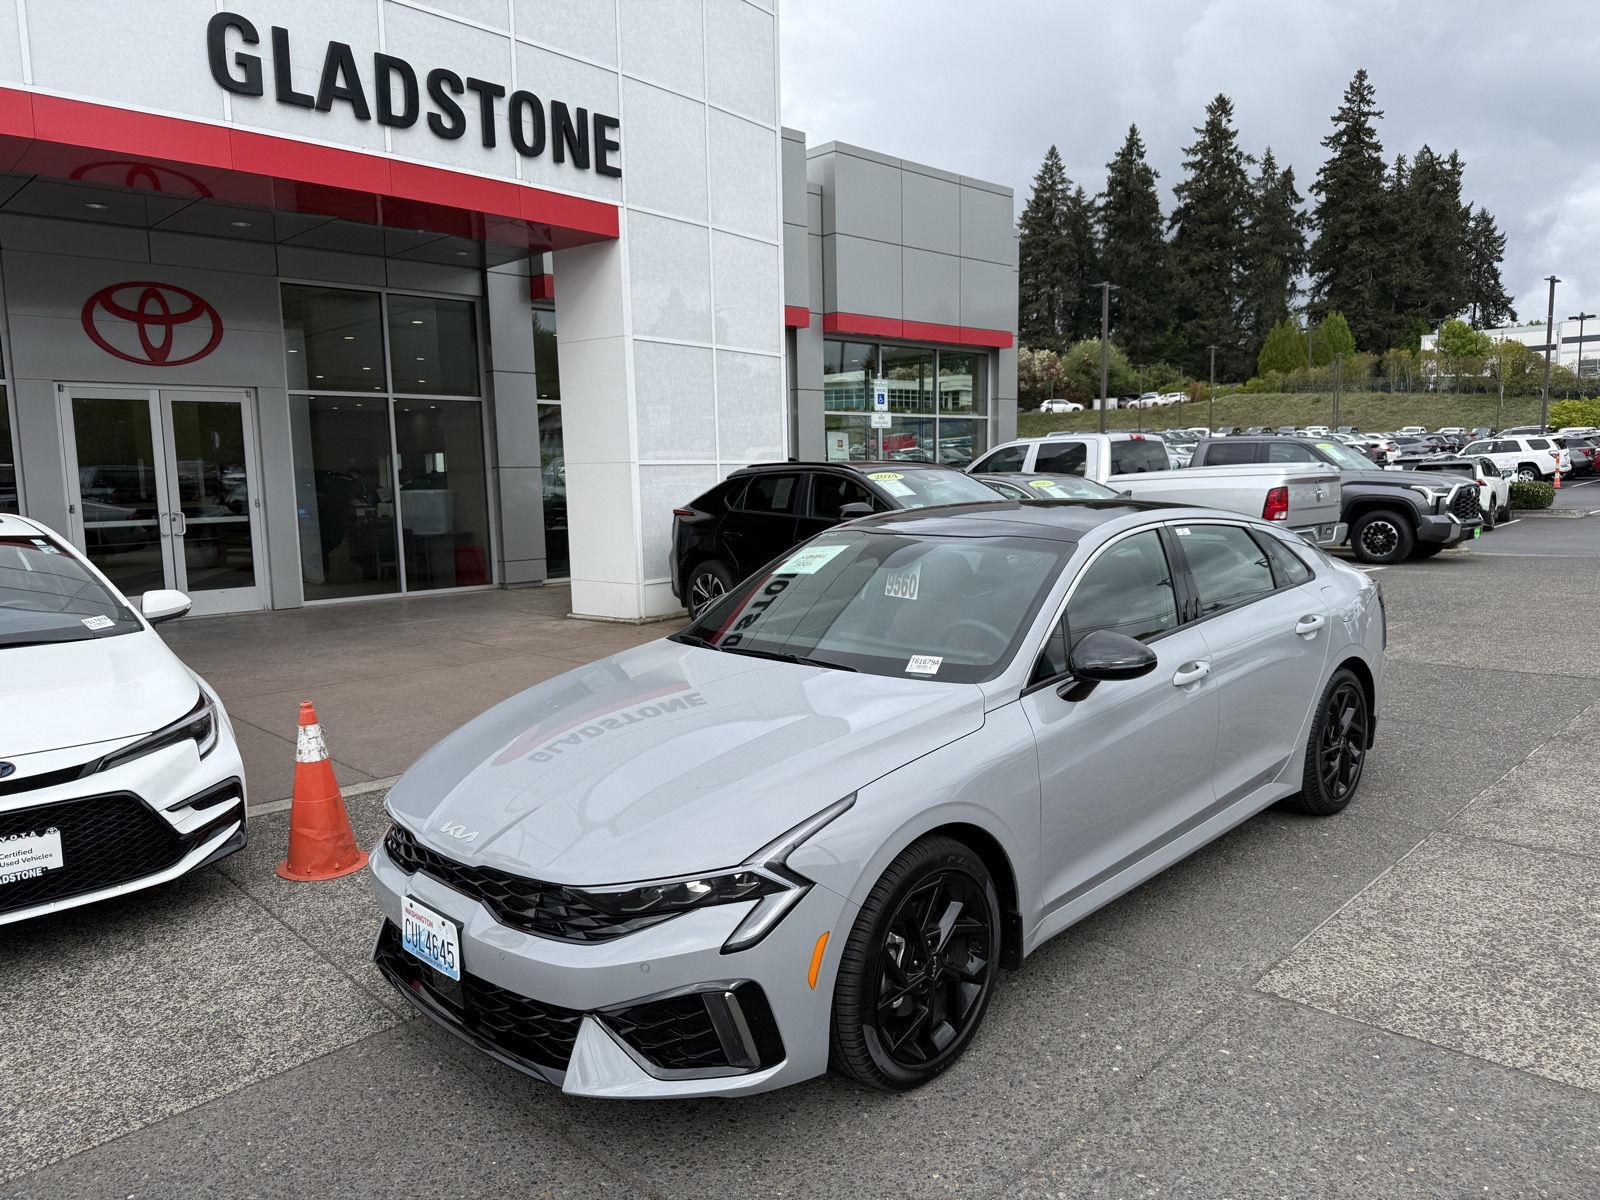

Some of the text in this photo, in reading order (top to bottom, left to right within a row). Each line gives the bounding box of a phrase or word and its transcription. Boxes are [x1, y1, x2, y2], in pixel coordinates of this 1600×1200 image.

[207, 12, 621, 178] GLADSTONE
[886, 573, 917, 599] 9560
[439, 821, 480, 843] KIA
[0, 847, 33, 860] Certified
[0, 852, 53, 868] Used Vehicles
[404, 905, 434, 929] WASHINGTON
[405, 918, 455, 970] CUL4645
